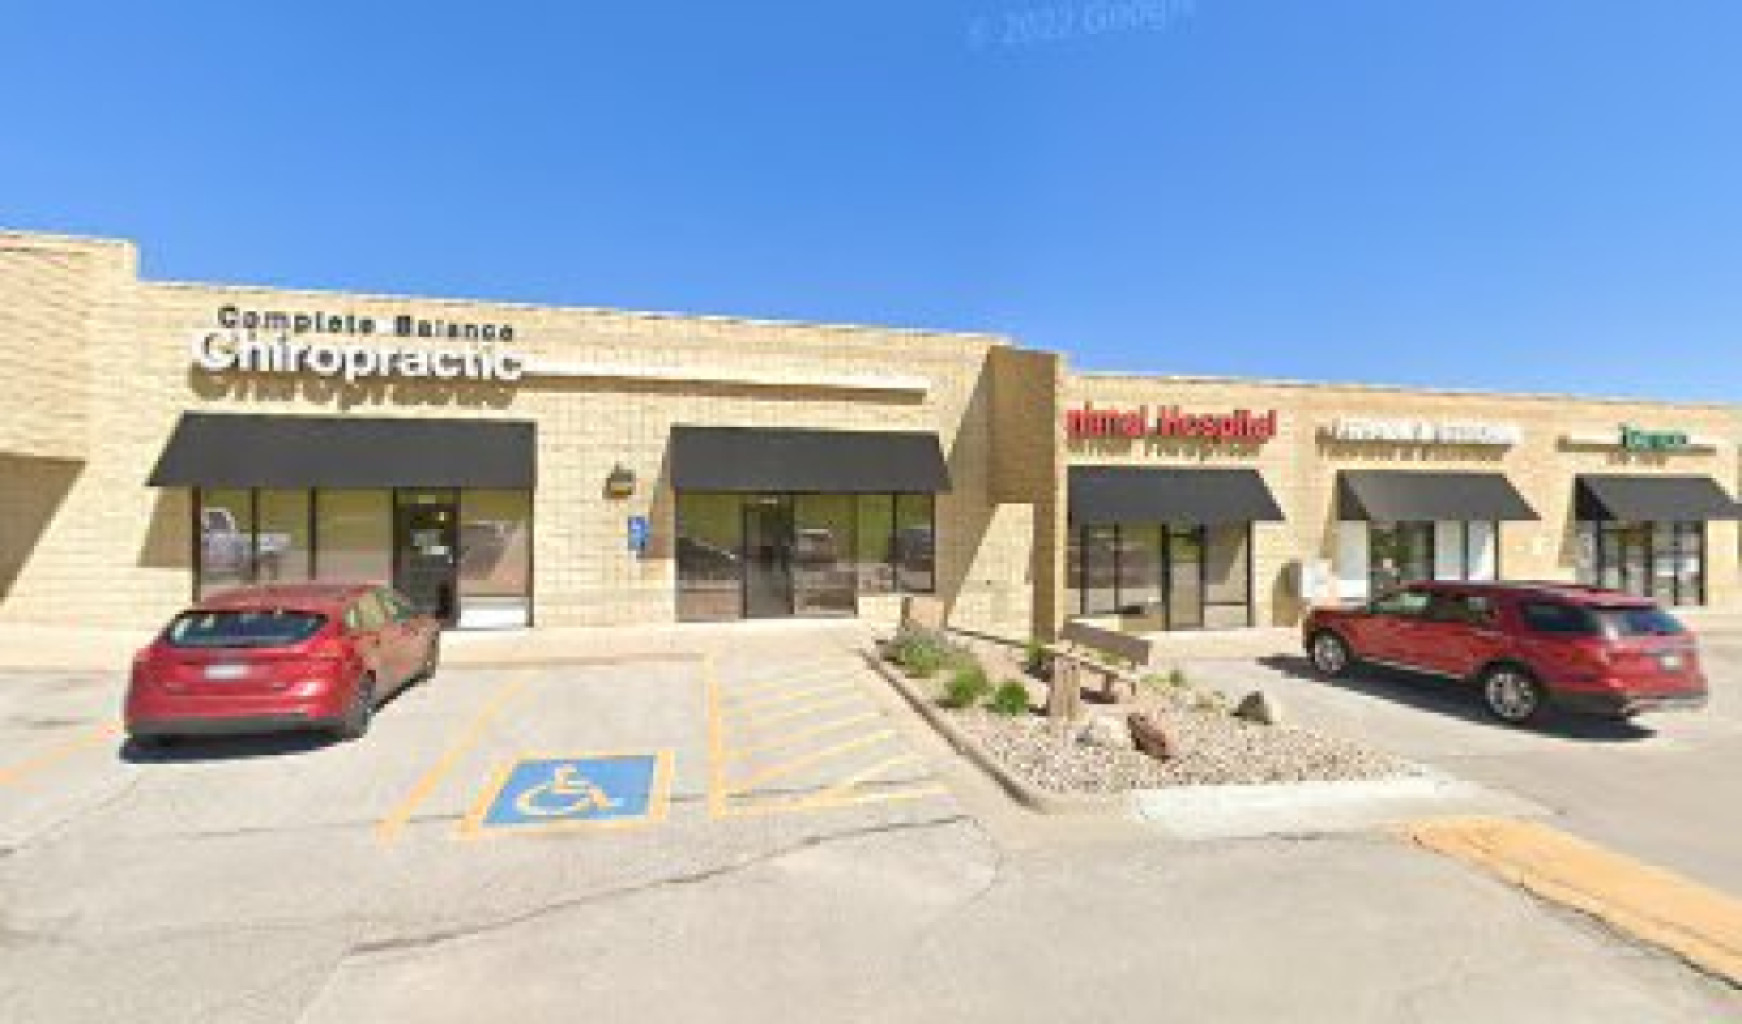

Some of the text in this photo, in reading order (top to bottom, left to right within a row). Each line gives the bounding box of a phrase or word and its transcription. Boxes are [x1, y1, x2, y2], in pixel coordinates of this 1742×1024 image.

[218, 305, 515, 343] Complete Balance
[192, 329, 524, 382] Chiropractic
[1066, 401, 1147, 438] nimal
[1157, 404, 1277, 442] Hospital
